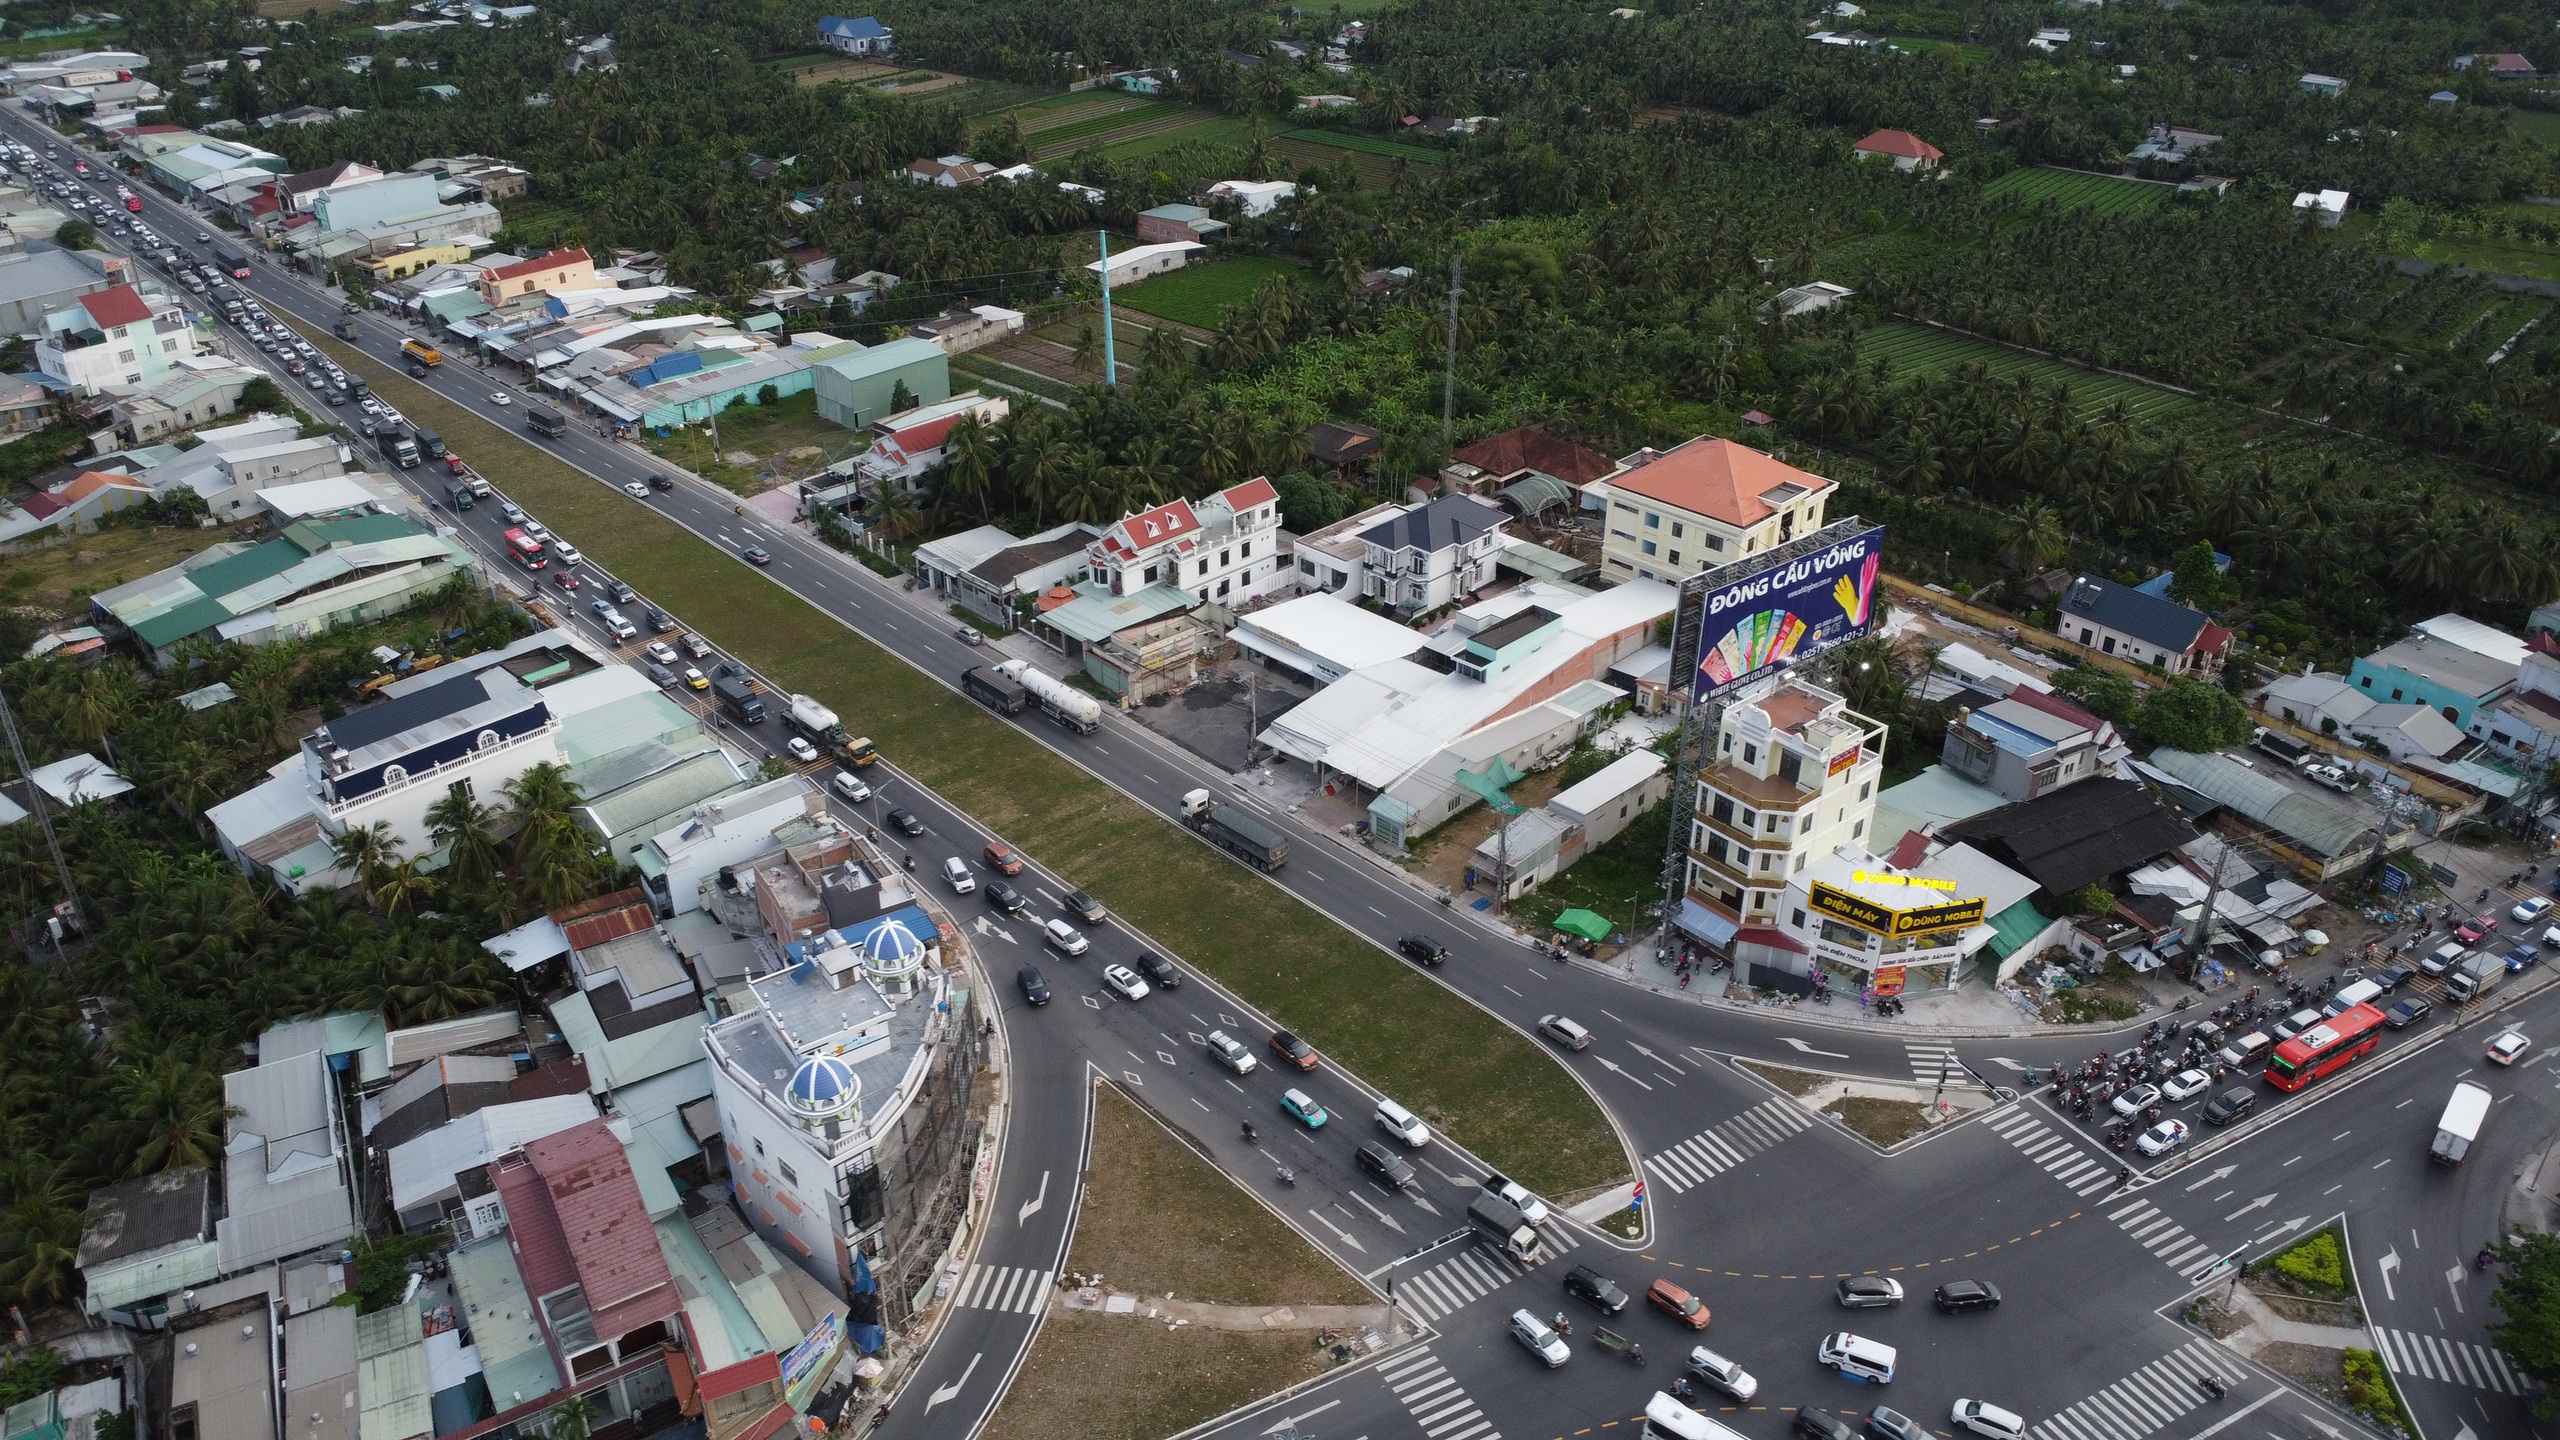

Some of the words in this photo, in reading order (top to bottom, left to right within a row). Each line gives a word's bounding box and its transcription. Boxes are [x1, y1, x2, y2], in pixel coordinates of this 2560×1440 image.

[1801, 646, 1821, 660] 0251
[1842, 627, 1865, 643] 421-2
[1710, 683, 1730, 698] WHITE
[1730, 673, 1750, 692] GLOVE
[1908, 877, 1957, 892] MOBILE
[1823, 896, 1852, 913] ĐIỆN
[1852, 907, 1880, 923] MÁY
[1913, 915, 1941, 927] DŨNG
[1944, 909, 1981, 922] MOBILE
